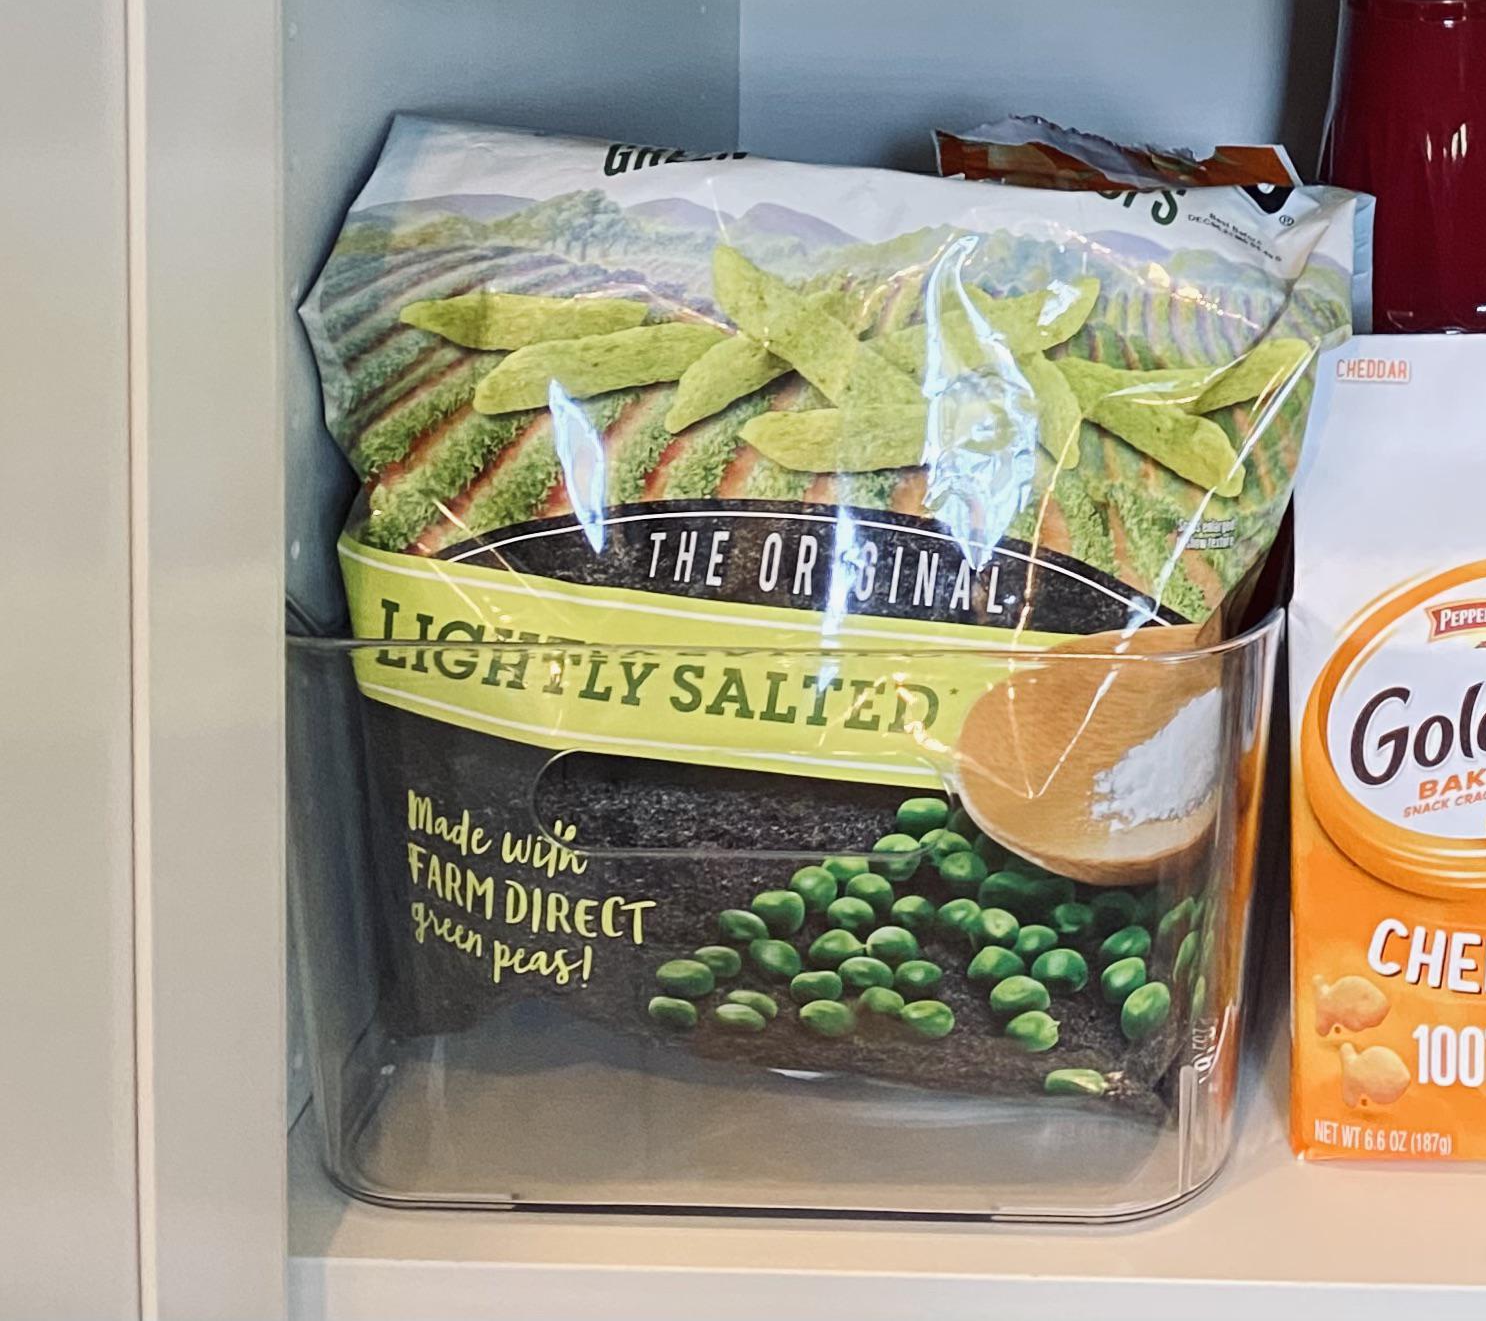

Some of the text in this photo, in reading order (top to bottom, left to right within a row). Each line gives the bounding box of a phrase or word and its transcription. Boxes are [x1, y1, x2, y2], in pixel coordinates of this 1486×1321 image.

[1336, 358, 1408, 380] CHEDDAR
[648, 531, 1005, 616] THE ORGINAL
[376, 598, 660, 707] LIGHTLY
[408, 789, 588, 878] Made with
[1403, 795, 1450, 818] SNACK
[408, 842, 657, 945] FARM DIRECT
[411, 901, 593, 988] green peas!
[1314, 1119, 1452, 1156] NET WT 6.6 OZ (187g)
